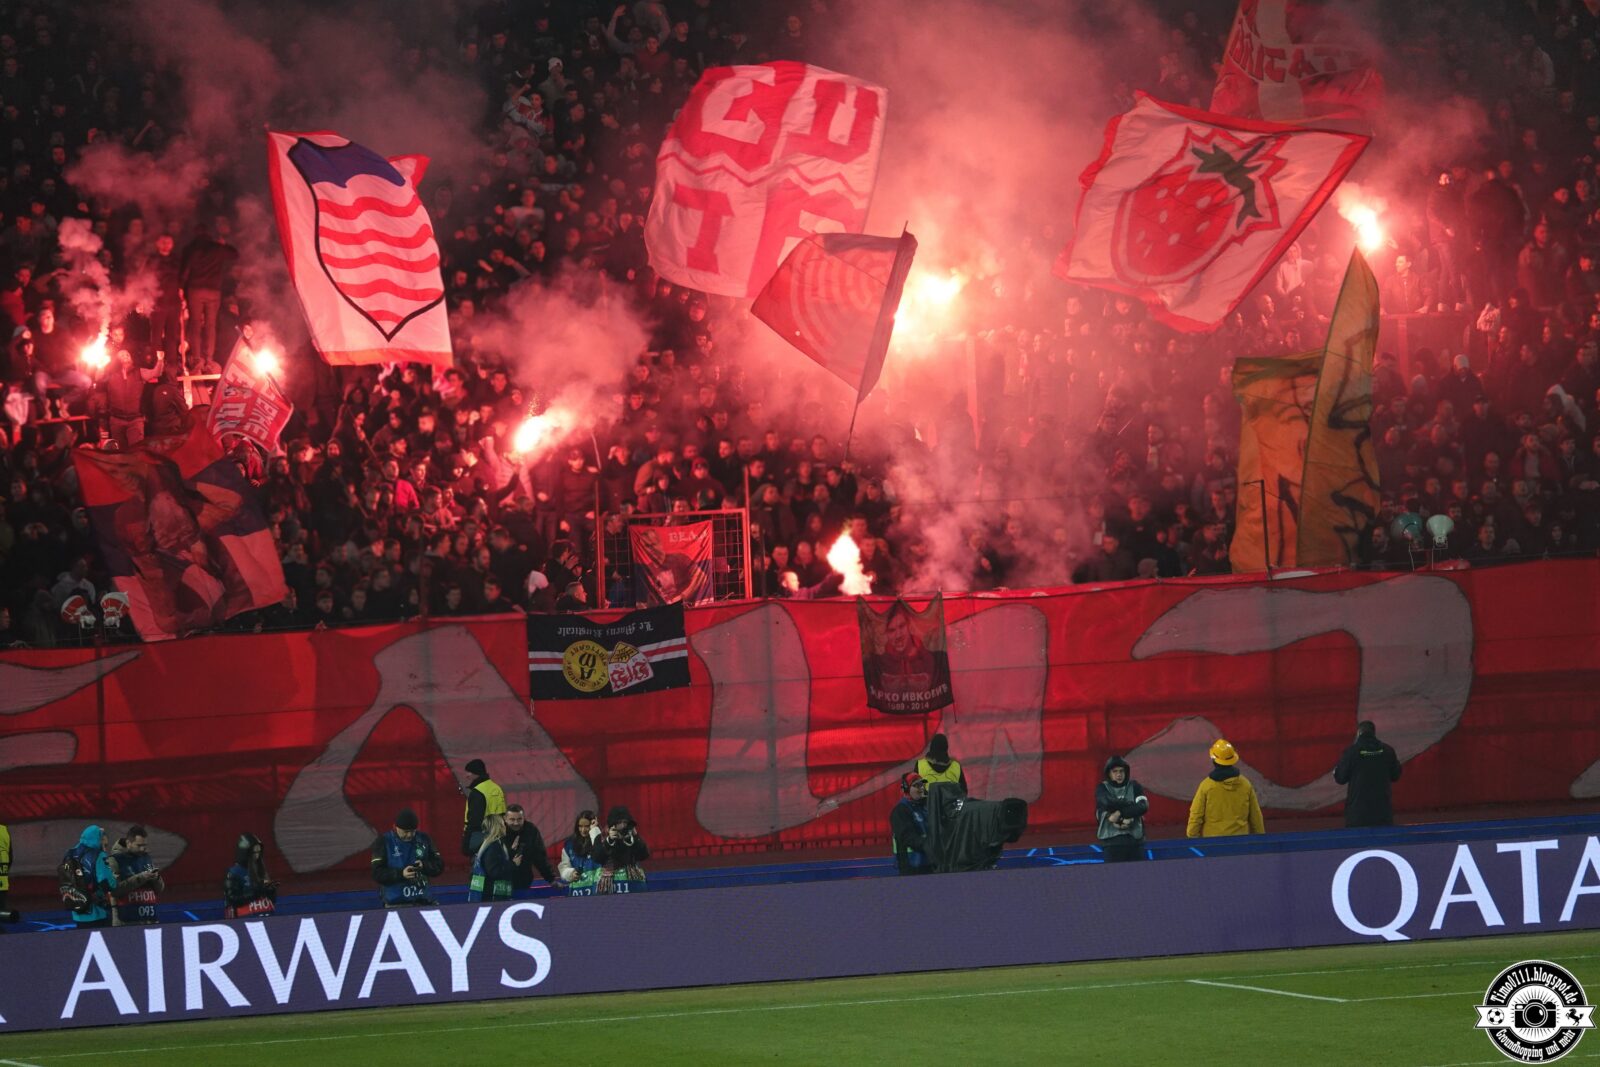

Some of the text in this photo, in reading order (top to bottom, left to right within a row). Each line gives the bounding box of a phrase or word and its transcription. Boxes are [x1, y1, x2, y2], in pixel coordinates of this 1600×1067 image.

[911, 701, 930, 711] 2014
[613, 882, 630, 894] 11
[138, 905, 155, 917] 093
[61, 903, 552, 1018] AIRWAYS
